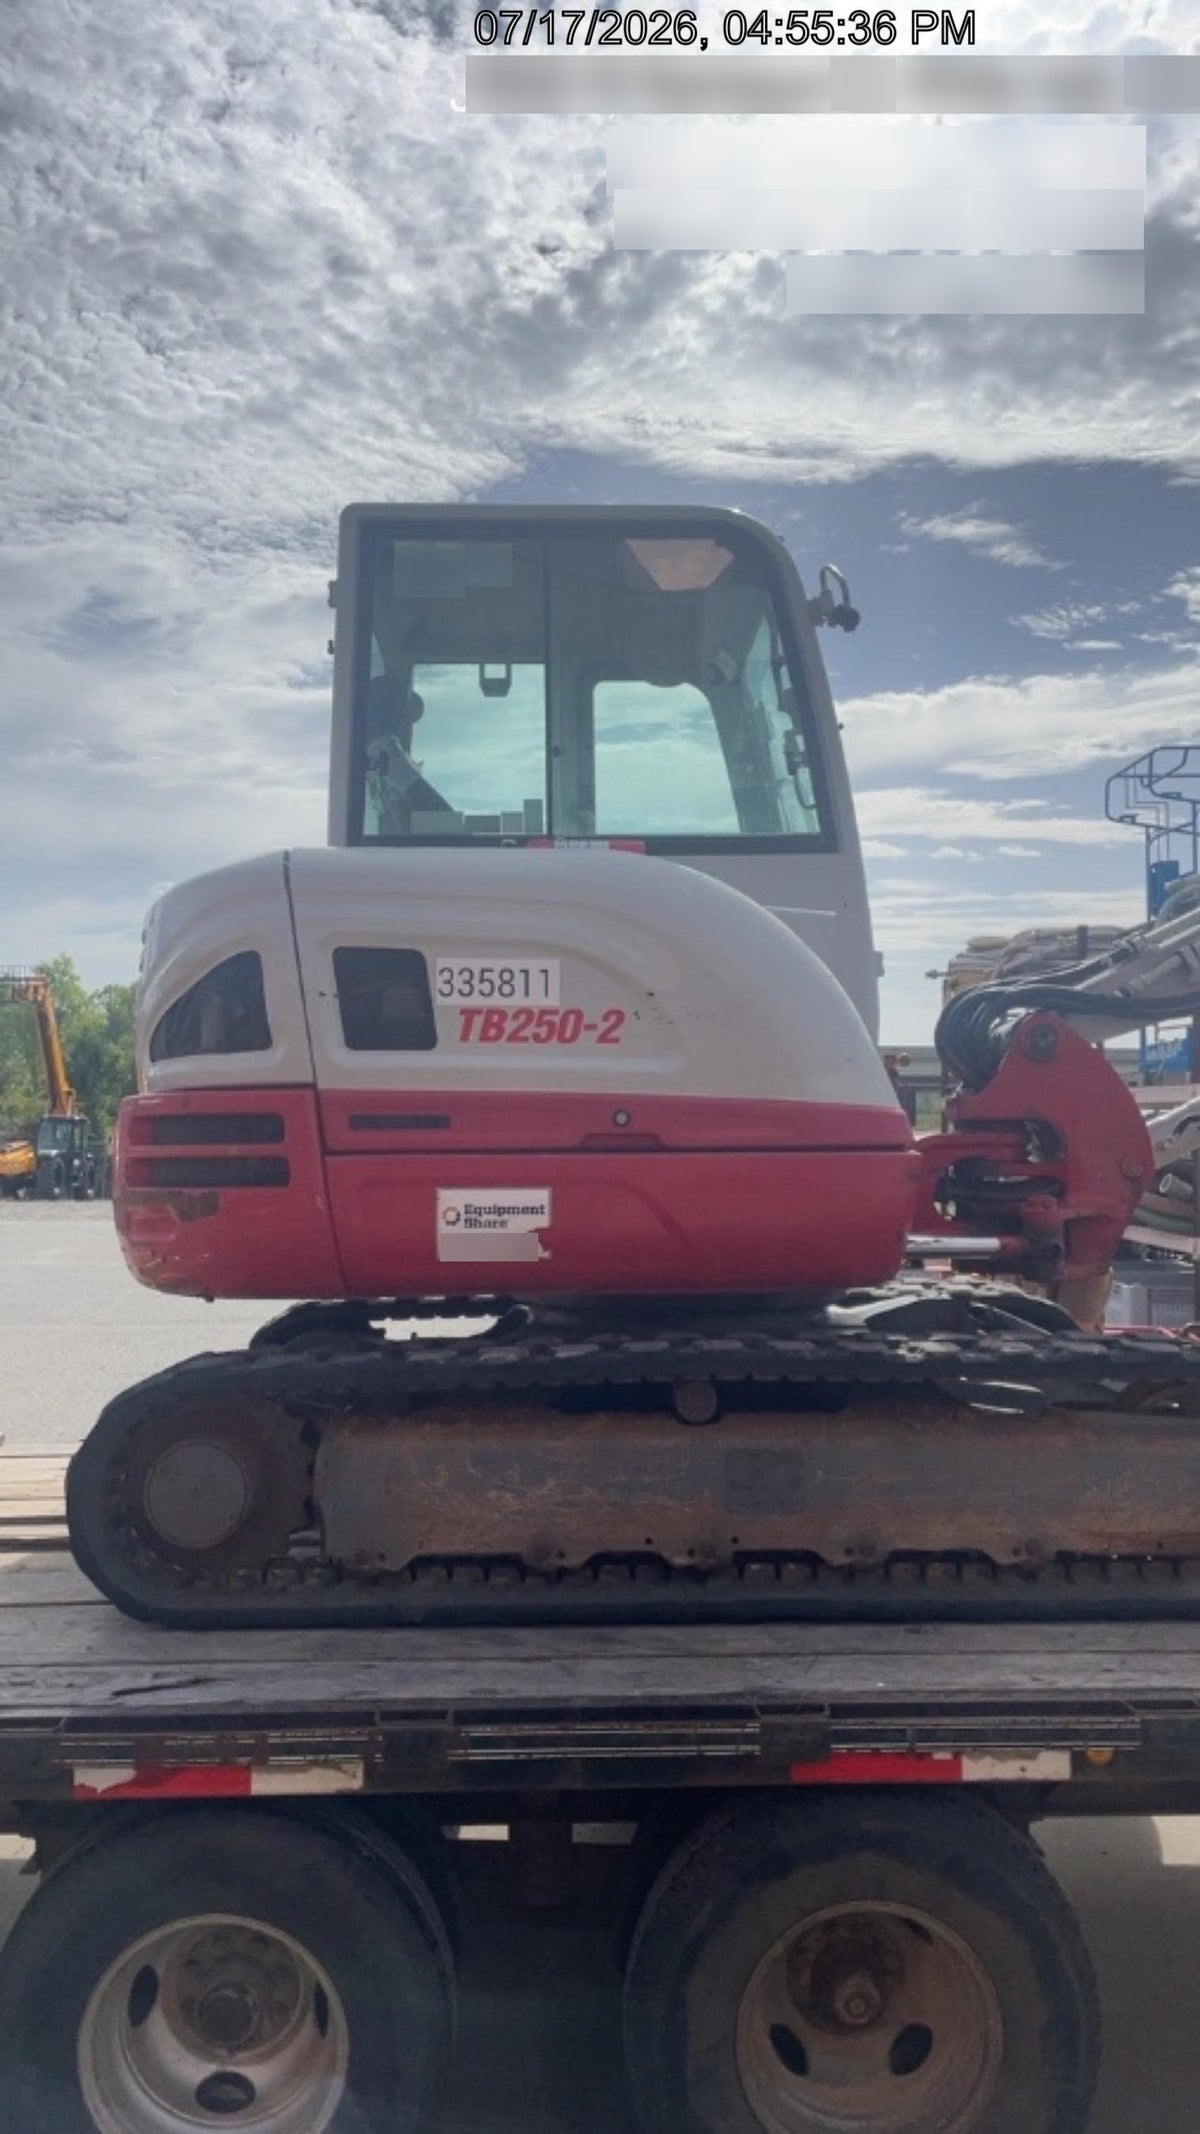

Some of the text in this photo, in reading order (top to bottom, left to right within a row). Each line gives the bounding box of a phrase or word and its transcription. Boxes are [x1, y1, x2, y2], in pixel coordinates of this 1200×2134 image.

[438, 967, 549, 998] 335811
[459, 1007, 626, 1044] TB250-2
[464, 1203, 546, 1217] Equipment
[464, 1217, 509, 1229] Share
